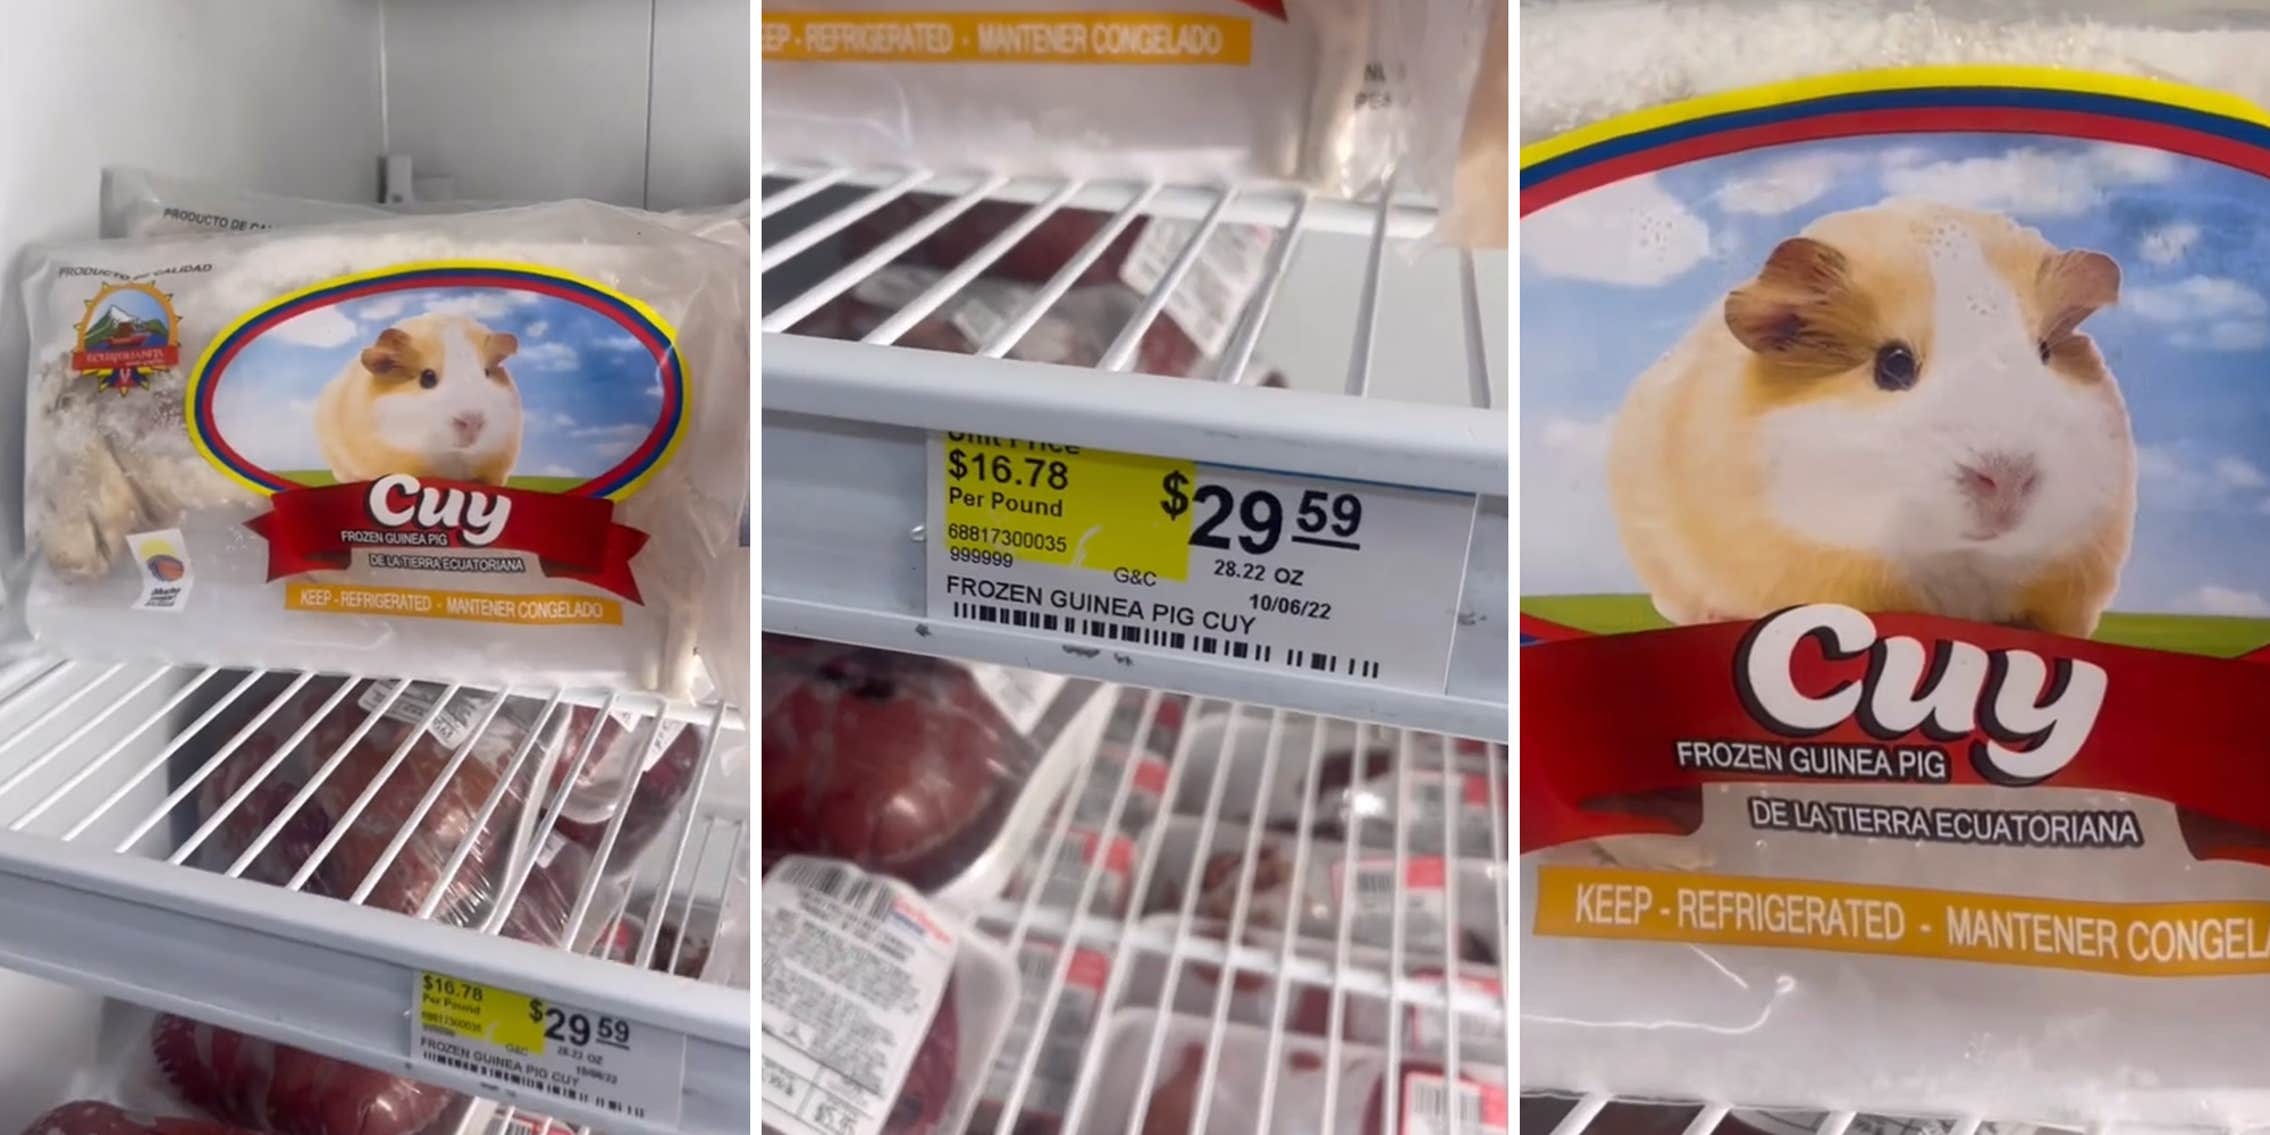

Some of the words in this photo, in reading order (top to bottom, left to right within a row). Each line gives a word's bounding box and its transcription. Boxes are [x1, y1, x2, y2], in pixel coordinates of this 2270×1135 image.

[805, 22, 954, 54] REFRIGERATED
[977, 22, 1088, 54] MANTENER
[1091, 22, 1223, 55] CONGELADO
[163, 207, 228, 230] PRODUCTO
[230, 219, 247, 231] DE
[948, 448, 1069, 490] $16.78
[366, 474, 512, 547] Cuy
[949, 486, 984, 508] Per
[992, 491, 1063, 517] Pound
[1296, 489, 1362, 537] 59
[341, 531, 384, 543] FROZEN
[385, 533, 427, 546] GUINEA
[428, 534, 448, 546] PIG
[948, 523, 1067, 552] 68817300035
[370, 554, 382, 566] DE
[386, 555, 399, 567] LA
[402, 556, 441, 570] TIERRA
[443, 558, 524, 572] ECUATORIANA
[950, 546, 1013, 568] 999999
[1113, 567, 1157, 587] G&C
[1213, 559, 1265, 581] 28.22
[1274, 568, 1304, 586] OZ
[301, 589, 332, 606] KEEP
[340, 590, 432, 611] REFRIGERATED
[447, 597, 515, 617] MANTENER
[517, 600, 603, 618] CONGELADO
[947, 575, 1042, 606] FROZEN
[1050, 590, 1144, 620] GUINEA
[1152, 604, 1194, 627] PIG
[1202, 611, 1256, 634] CUY
[1250, 594, 1331, 620] 10/06/22
[1734, 602, 2108, 787] Cuy
[1676, 741, 1783, 770] FROZEN
[1789, 747, 1892, 775] GUINEA
[1899, 751, 1945, 777] PIG
[1753, 800, 1788, 825] DE
[1796, 803, 1827, 829] LA
[1832, 806, 1929, 836] TIERRA
[1937, 812, 2139, 843] ECUATORIANA
[1575, 883, 1653, 926] KEEP
[1677, 887, 1906, 941] REFRIGERATED
[1946, 905, 2119, 959] MANTENER
[422, 974, 484, 1001] $16.78
[596, 1017, 630, 1043] 59
[420, 1038, 470, 1060] FROZEN
[473, 1050, 522, 1074] GUINEA
[525, 1063, 548, 1080] PIG
[551, 1070, 580, 1088] CUY
